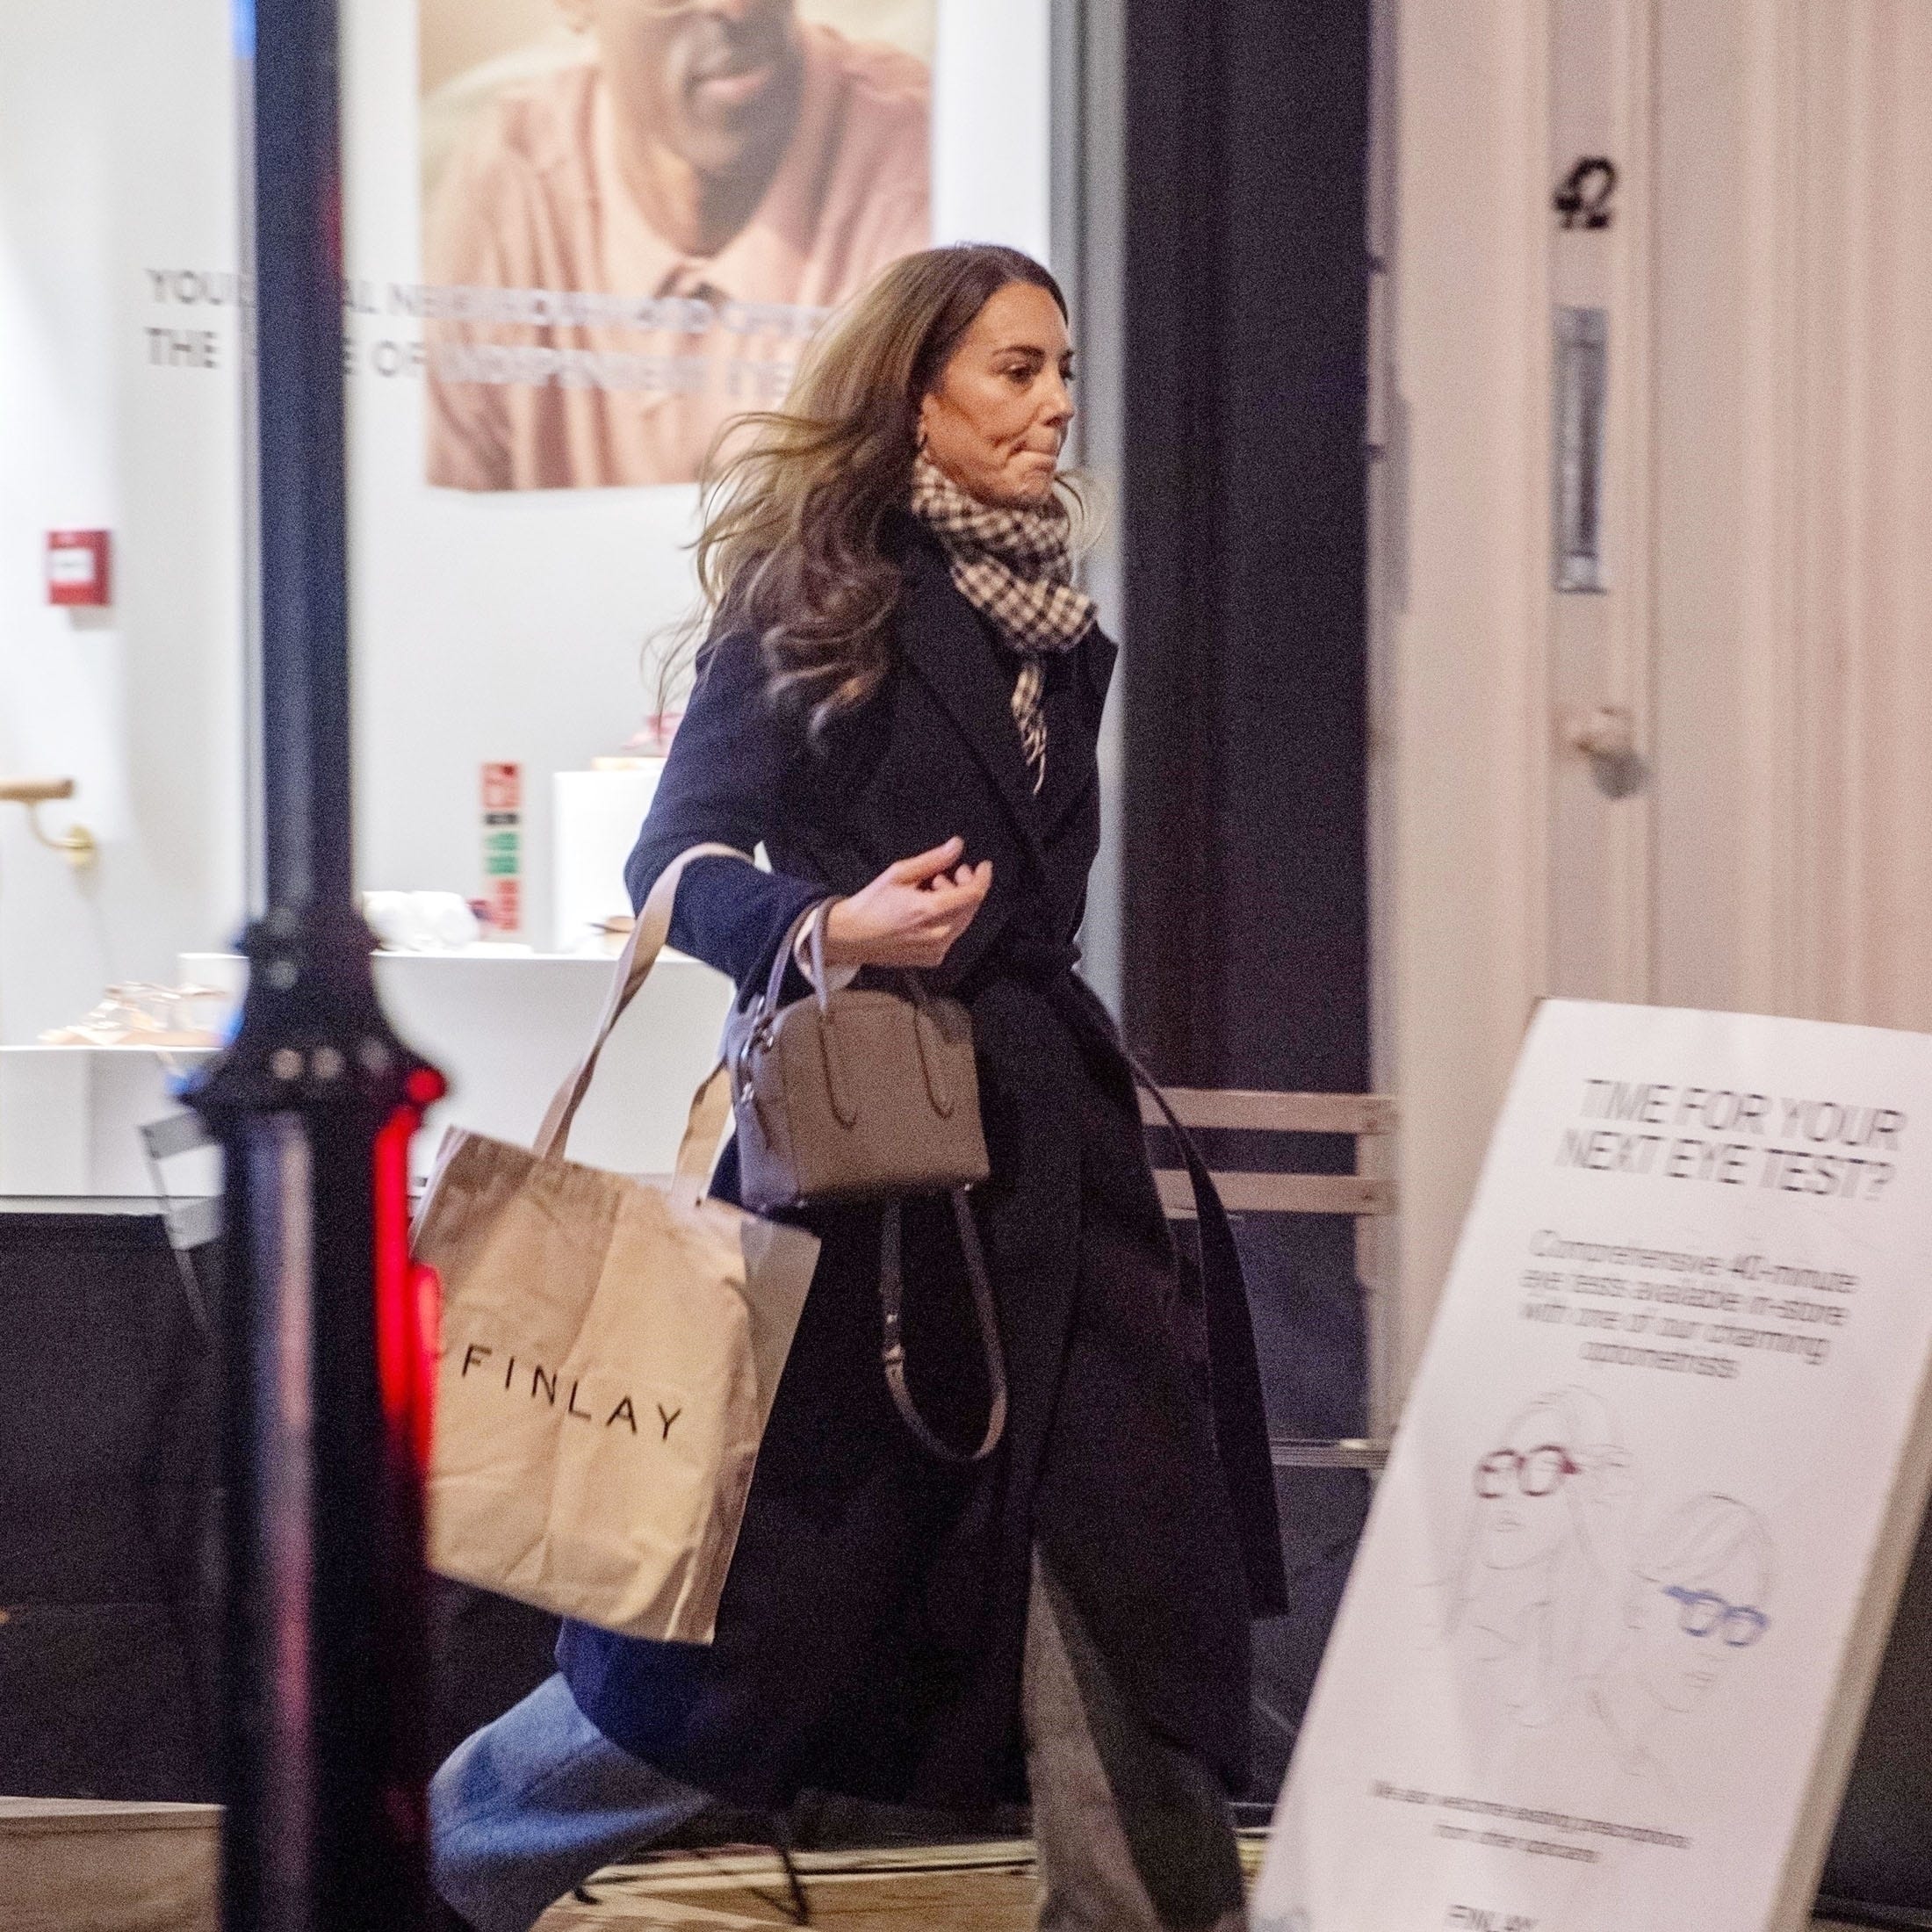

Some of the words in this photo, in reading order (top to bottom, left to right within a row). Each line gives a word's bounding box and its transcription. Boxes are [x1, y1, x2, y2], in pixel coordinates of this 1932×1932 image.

[144, 326, 219, 369] THE
[1580, 1078, 1675, 1127] TIME
[1681, 1086, 1771, 1136] FOR
[1778, 1096, 1909, 1152] YOUR
[1553, 1128, 1663, 1176] NEXT
[1663, 1137, 1757, 1187] EYE
[1760, 1148, 1897, 1202] TEST?
[462, 1344, 682, 1441] FINLAY
